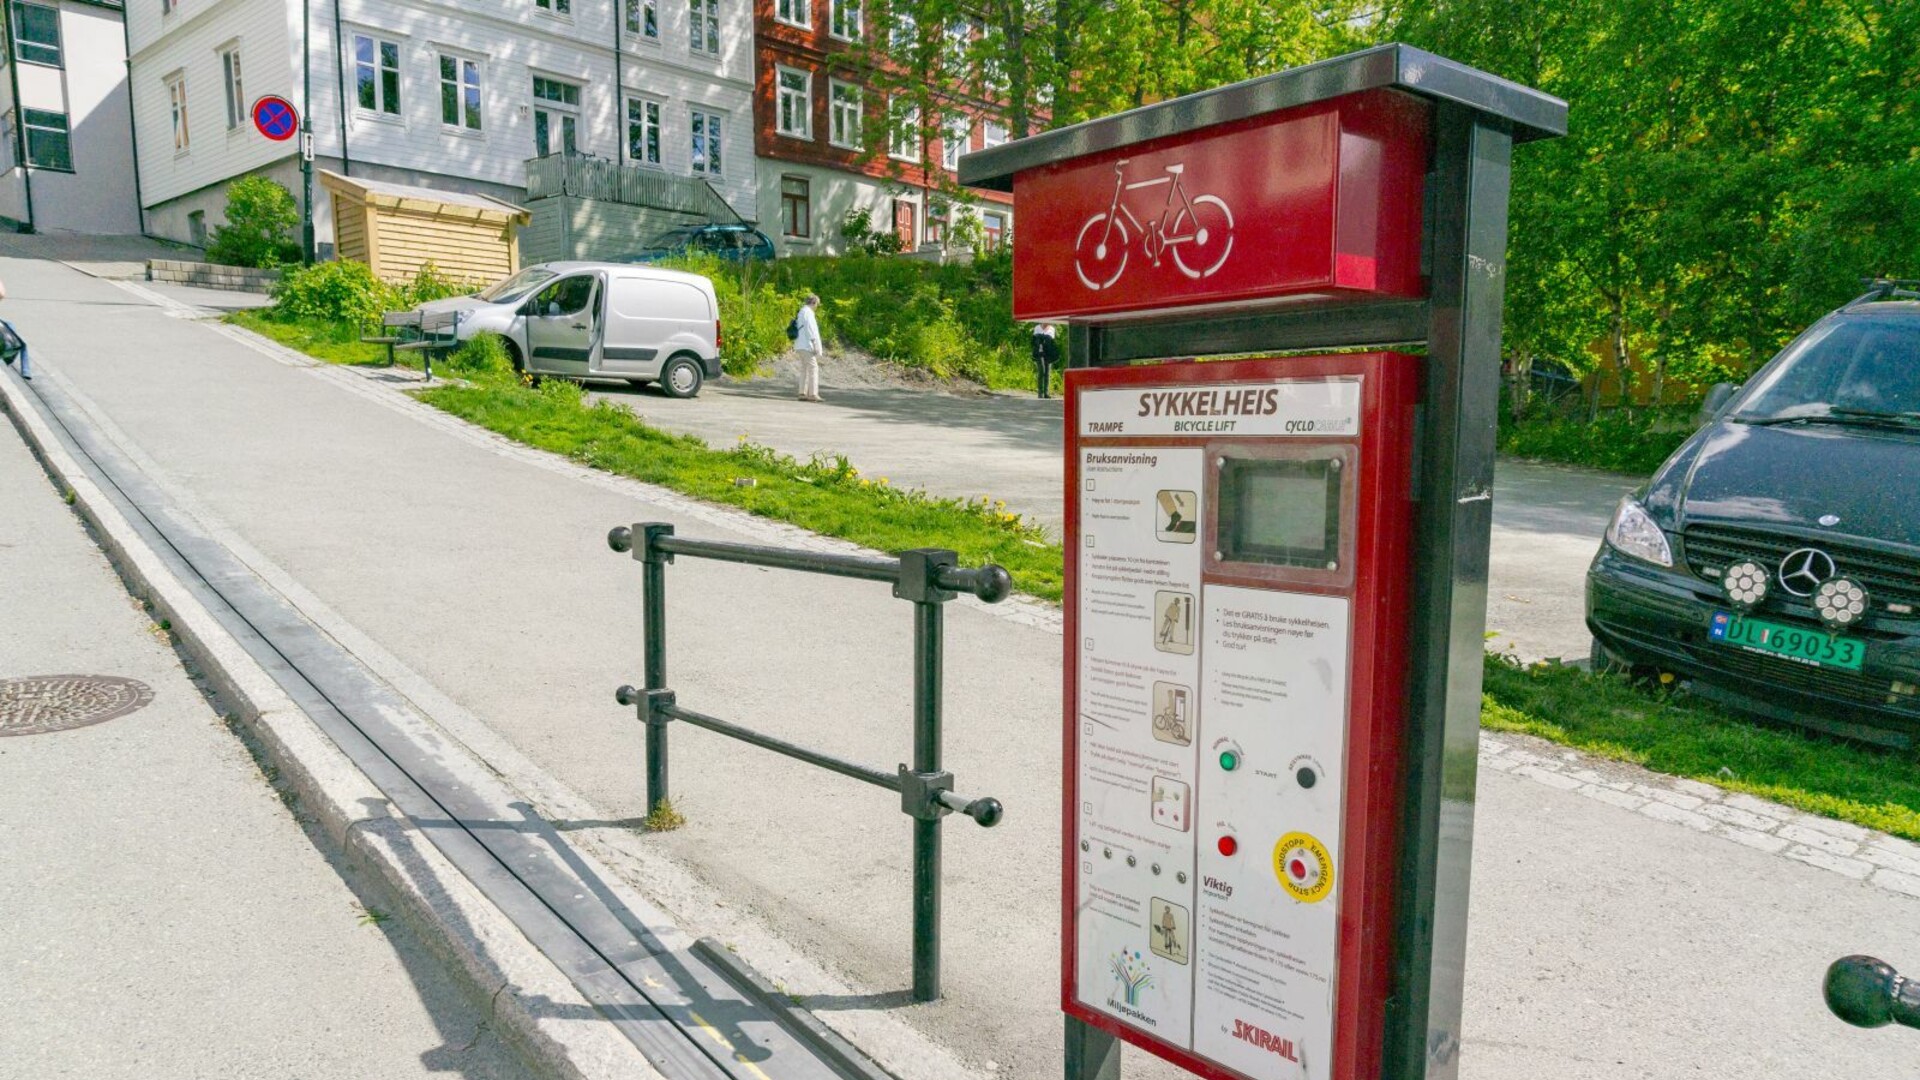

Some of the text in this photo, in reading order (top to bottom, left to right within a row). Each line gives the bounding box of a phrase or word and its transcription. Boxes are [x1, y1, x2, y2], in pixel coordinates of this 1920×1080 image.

[1137, 388, 1279, 418] SYKKELHEIS
[1088, 421, 1124, 433] TRAMPE
[1174, 420, 1236, 432] BICYCLE LIFT
[1086, 453, 1158, 467] Bruksanvisning
[1242, 610, 1263, 620] GRATIS
[1264, 612, 1268, 621] å
[1269, 615, 1287, 623] bruke
[1223, 620, 1232, 628] Les
[1304, 629, 1314, 638] før
[1223, 640, 1235, 649] God
[1253, 634, 1261, 643] på
[1728, 618, 1758, 645] DL
[1770, 629, 1856, 664] 69053
[1255, 769, 1277, 779] START
[1309, 844, 1328, 895] EMERGENCY
[1203, 875, 1233, 897] Viktig
[1288, 882, 1309, 896] STOP
[1106, 997, 1157, 1028] Miljøpakken
[1231, 1018, 1299, 1064] SKIRAIL
